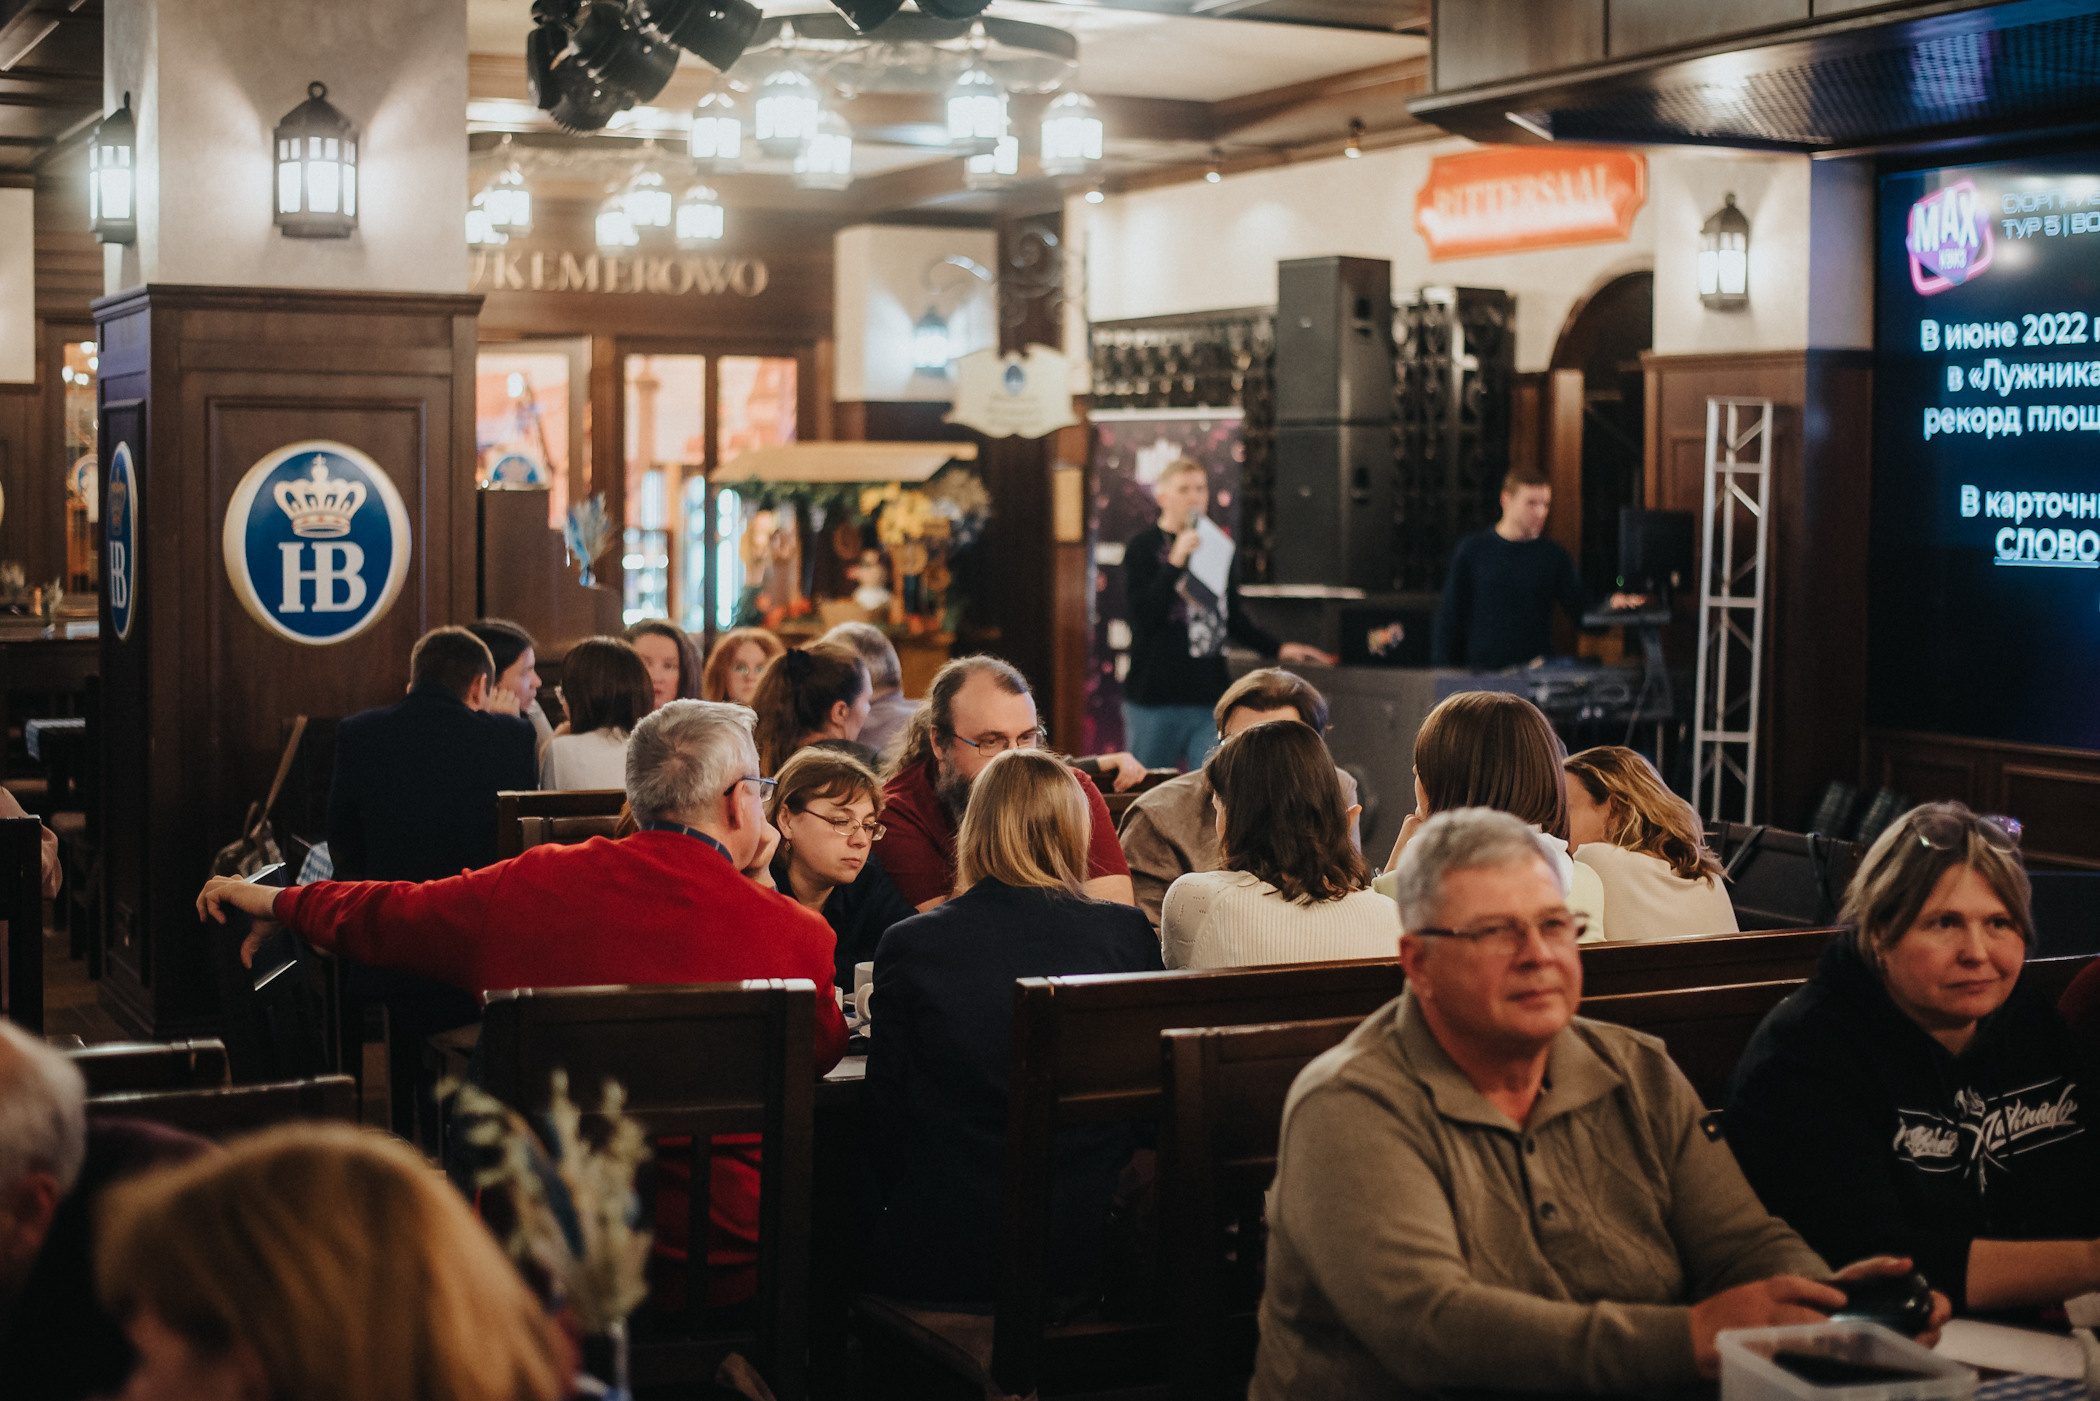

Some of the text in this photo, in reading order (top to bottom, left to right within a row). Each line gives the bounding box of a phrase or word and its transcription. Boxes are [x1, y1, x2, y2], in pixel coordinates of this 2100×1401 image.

[1912, 186, 1980, 253] MAX
[2044, 214, 2061, 237] 5
[1920, 318, 1940, 352] В
[1944, 321, 2018, 351] июне
[2021, 311, 2088, 346] 2022
[1947, 365, 1964, 392] в
[1923, 406, 2022, 441] рекорд
[1960, 484, 2100, 525] В карточн
[1994, 526, 2100, 562] СЛОВО
[108, 540, 128, 609] HB
[277, 540, 368, 614] HB
